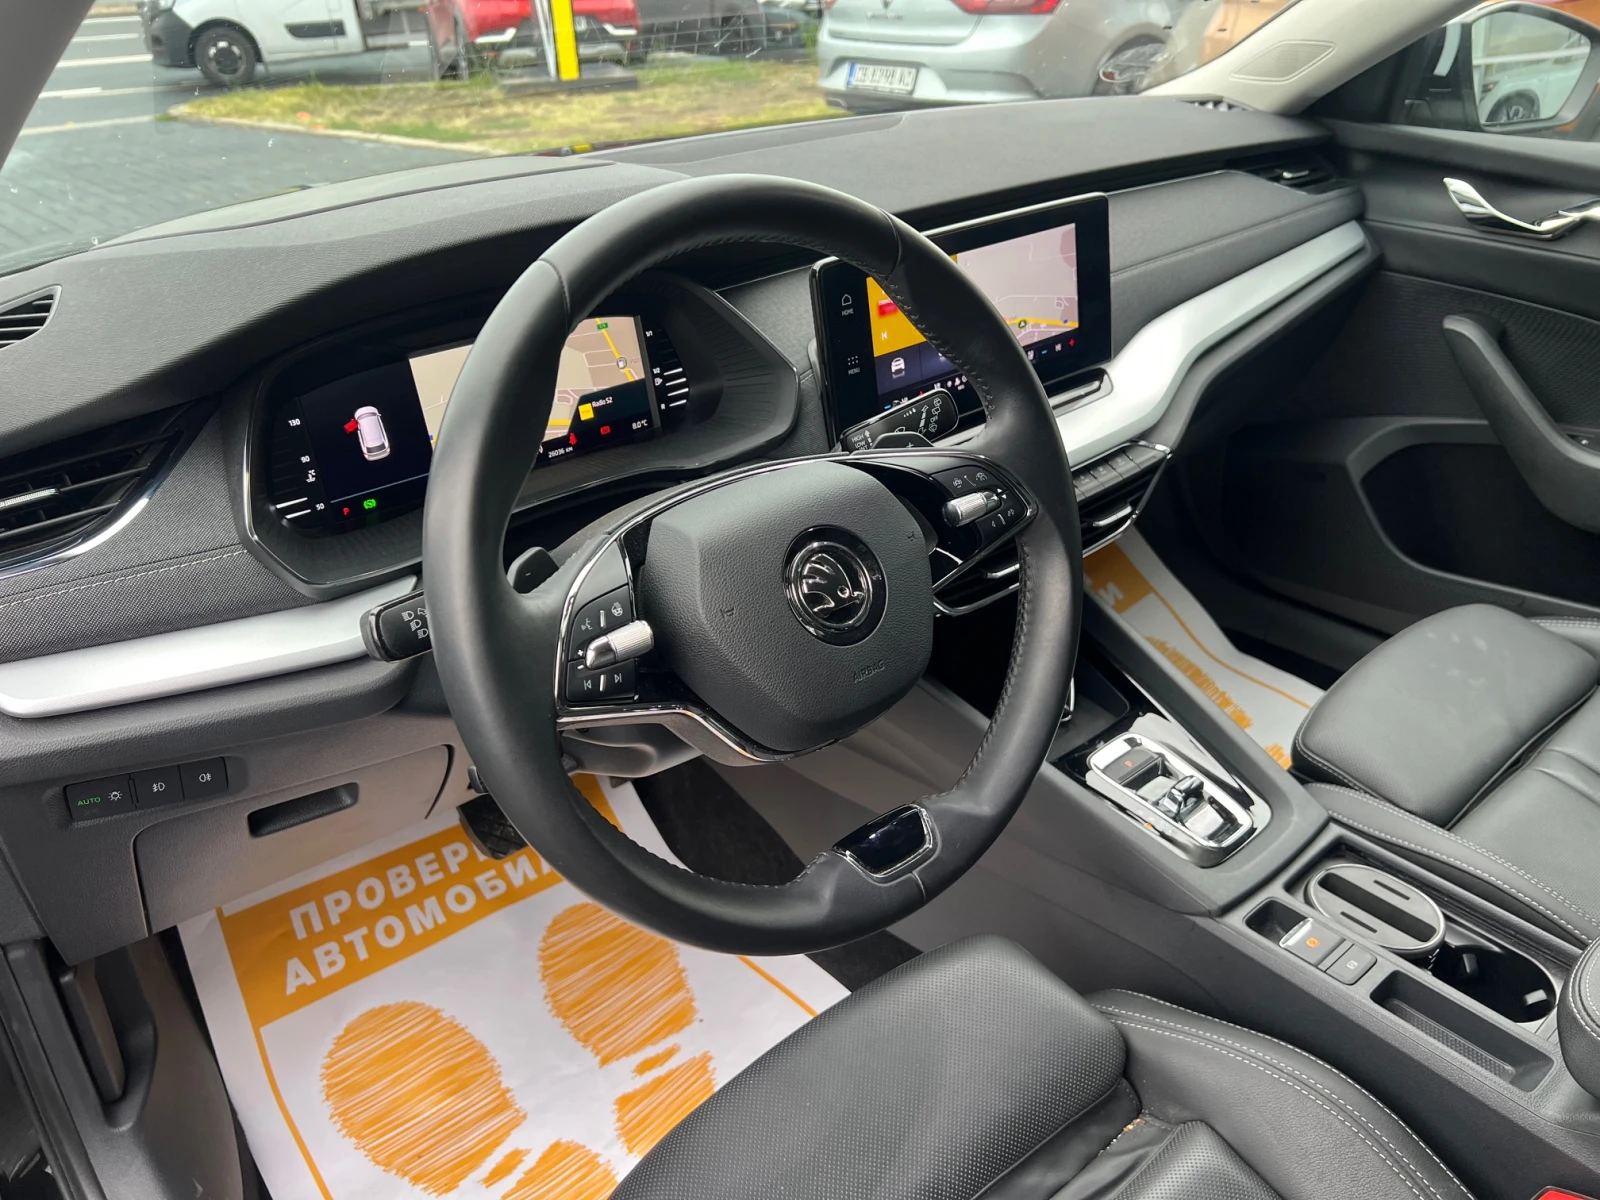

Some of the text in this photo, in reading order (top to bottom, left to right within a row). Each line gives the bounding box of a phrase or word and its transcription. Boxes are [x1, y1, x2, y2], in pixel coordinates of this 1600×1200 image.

[841, 308, 854, 316] HOME
[653, 367, 661, 375] 1/2
[848, 367, 861, 376] MENU
[591, 398, 606, 408] Radio
[288, 418, 301, 427] 130
[851, 434, 864, 443] HIGH
[548, 448, 565, 458] 26036
[300, 455, 311, 463] 90
[315, 502, 325, 511] 50
[343, 507, 350, 515] P
[853, 659, 885, 683] AIRBAG
[77, 797, 101, 806] AUTO
